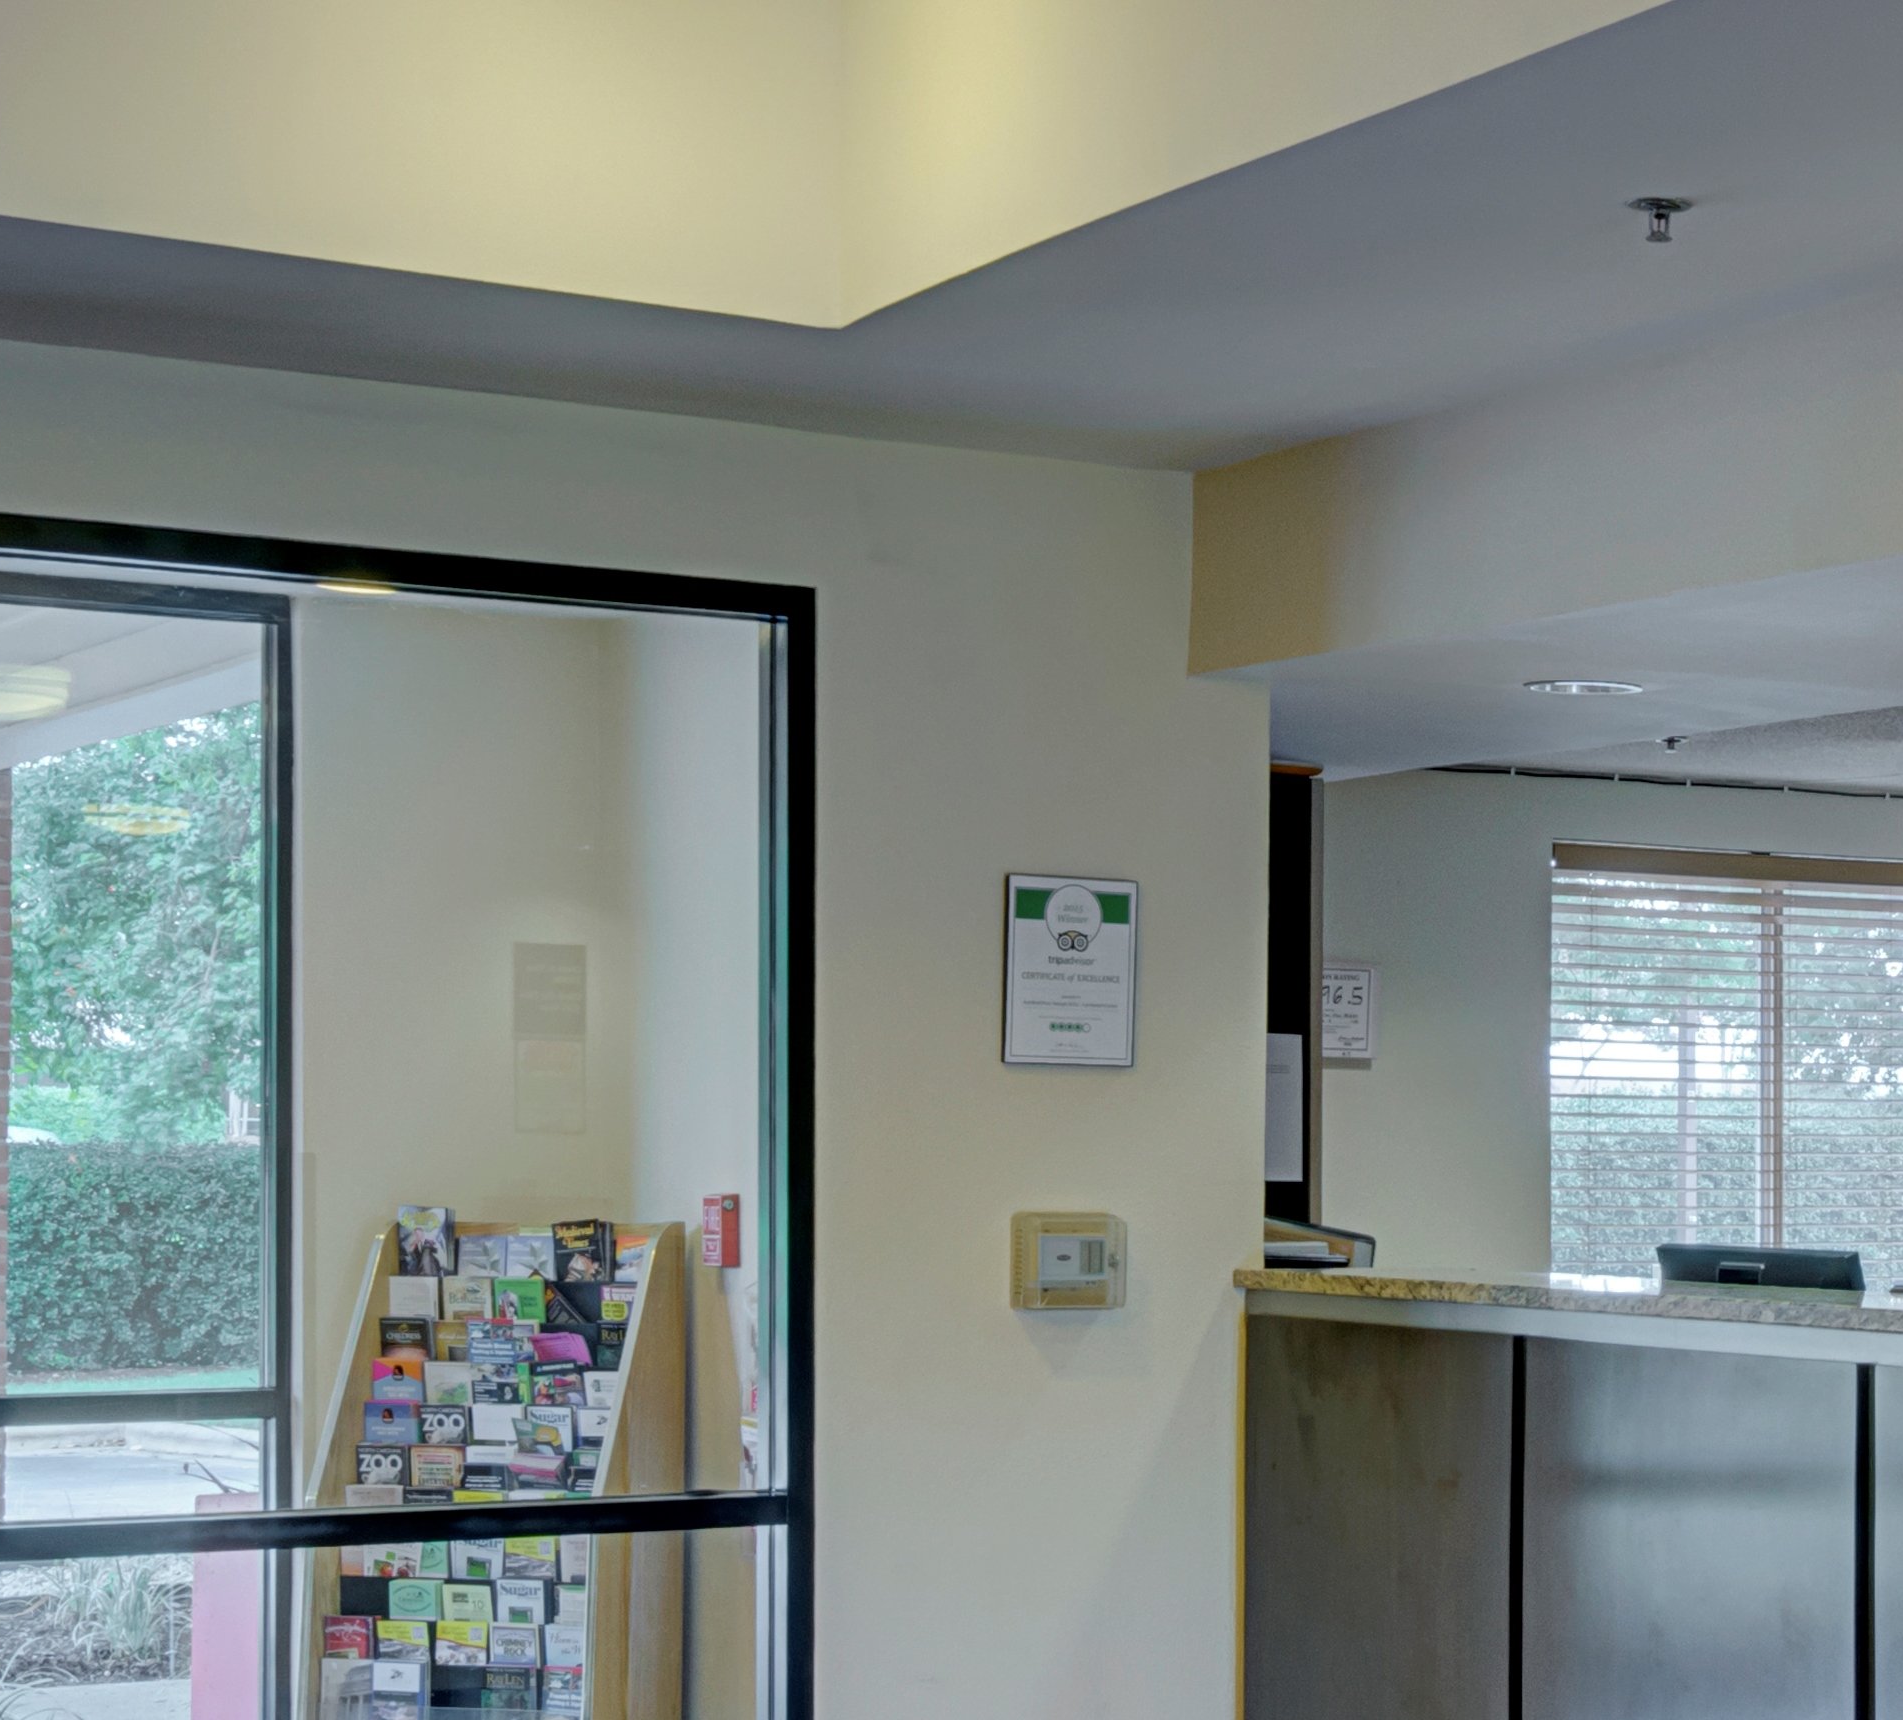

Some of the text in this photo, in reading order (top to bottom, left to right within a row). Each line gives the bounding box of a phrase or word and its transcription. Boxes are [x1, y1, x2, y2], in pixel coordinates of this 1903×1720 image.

[421, 1413, 465, 1432] ZOO
[529, 1409, 569, 1424] Sugar
[358, 1454, 402, 1472] ZOO
[499, 1583, 542, 1597] Sugar
